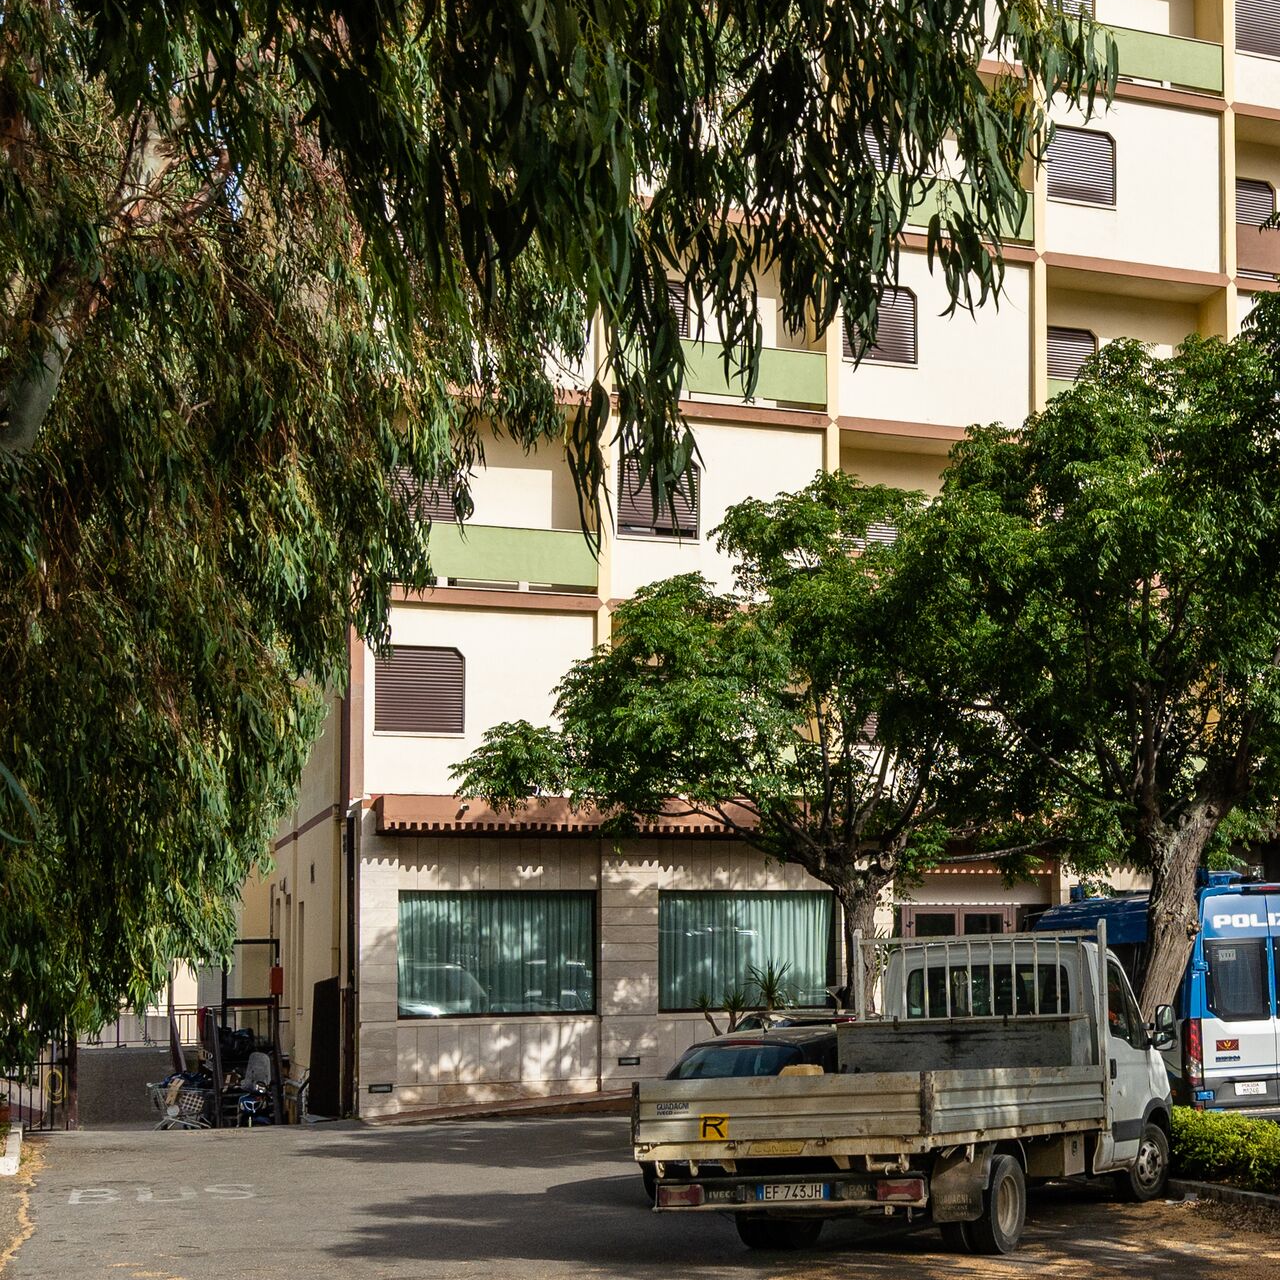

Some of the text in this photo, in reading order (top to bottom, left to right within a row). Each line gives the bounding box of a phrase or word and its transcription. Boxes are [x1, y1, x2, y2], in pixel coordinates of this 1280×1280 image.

[656, 1103, 689, 1111] GUADAGNI
[702, 1116, 725, 1138] R
[68, 1183, 256, 1205] BUS
[765, 1184, 823, 1199] EF 743JH
